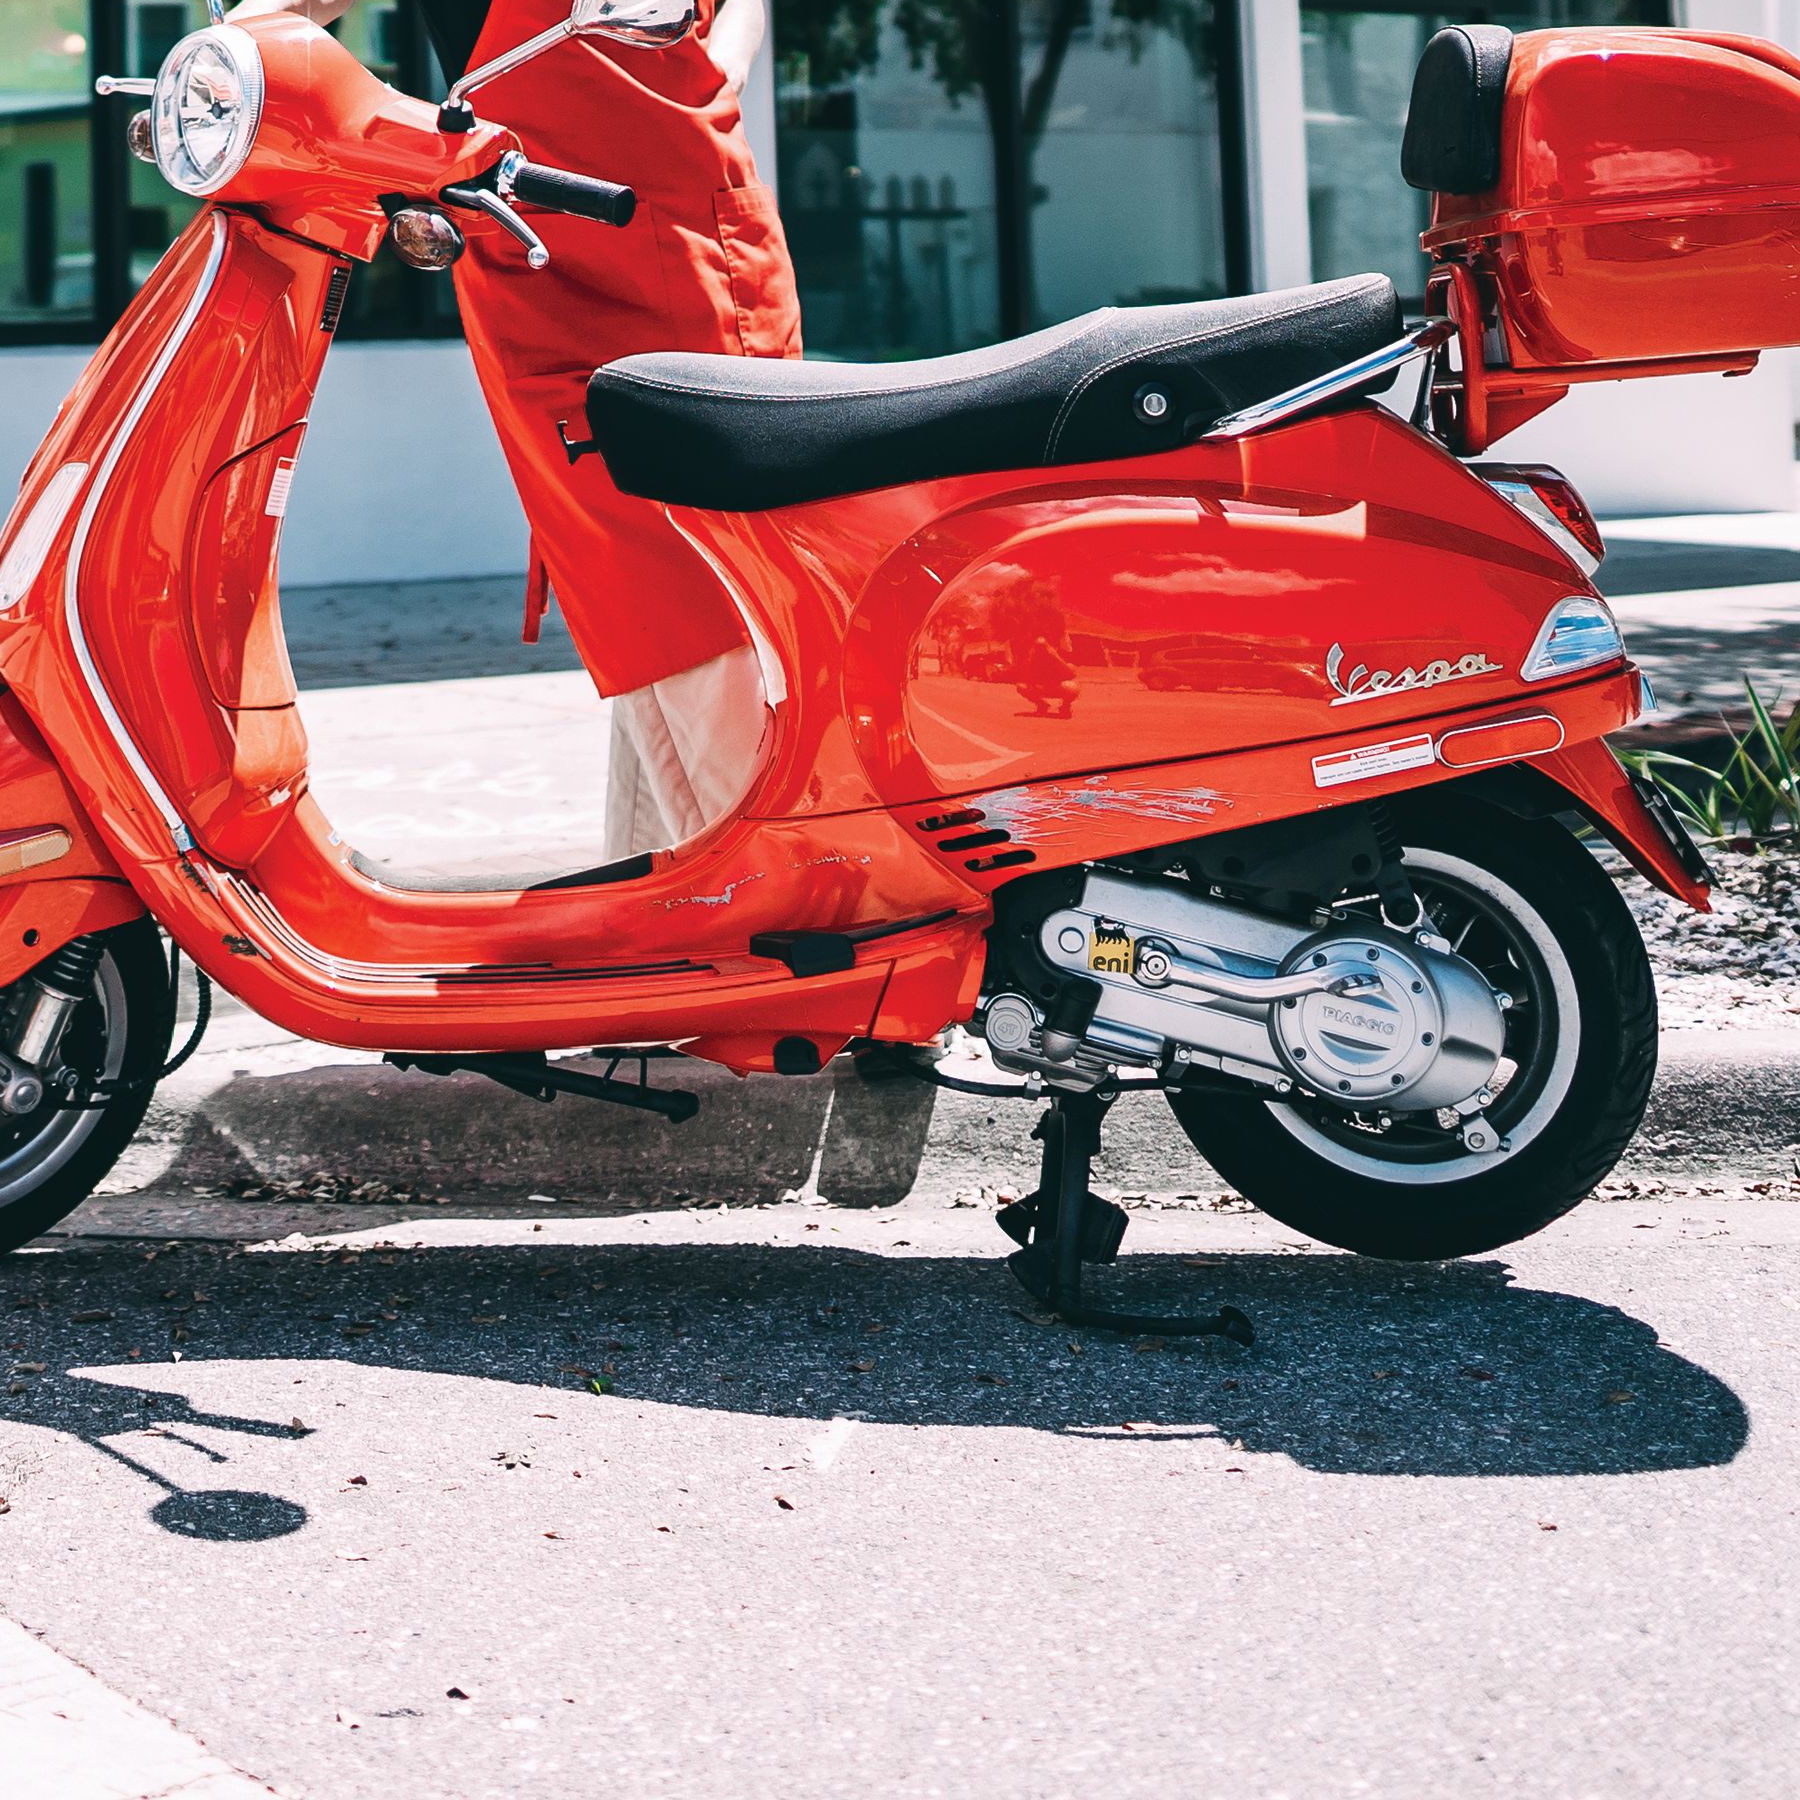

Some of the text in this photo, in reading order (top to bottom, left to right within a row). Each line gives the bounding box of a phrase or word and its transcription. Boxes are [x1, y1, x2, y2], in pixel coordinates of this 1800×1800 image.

[1326, 642, 1504, 707] Vespa
[1093, 951, 1129, 973] eni
[997, 1021, 1019, 1036] 4T
[1322, 1005, 1397, 1036] PIAGGIO
